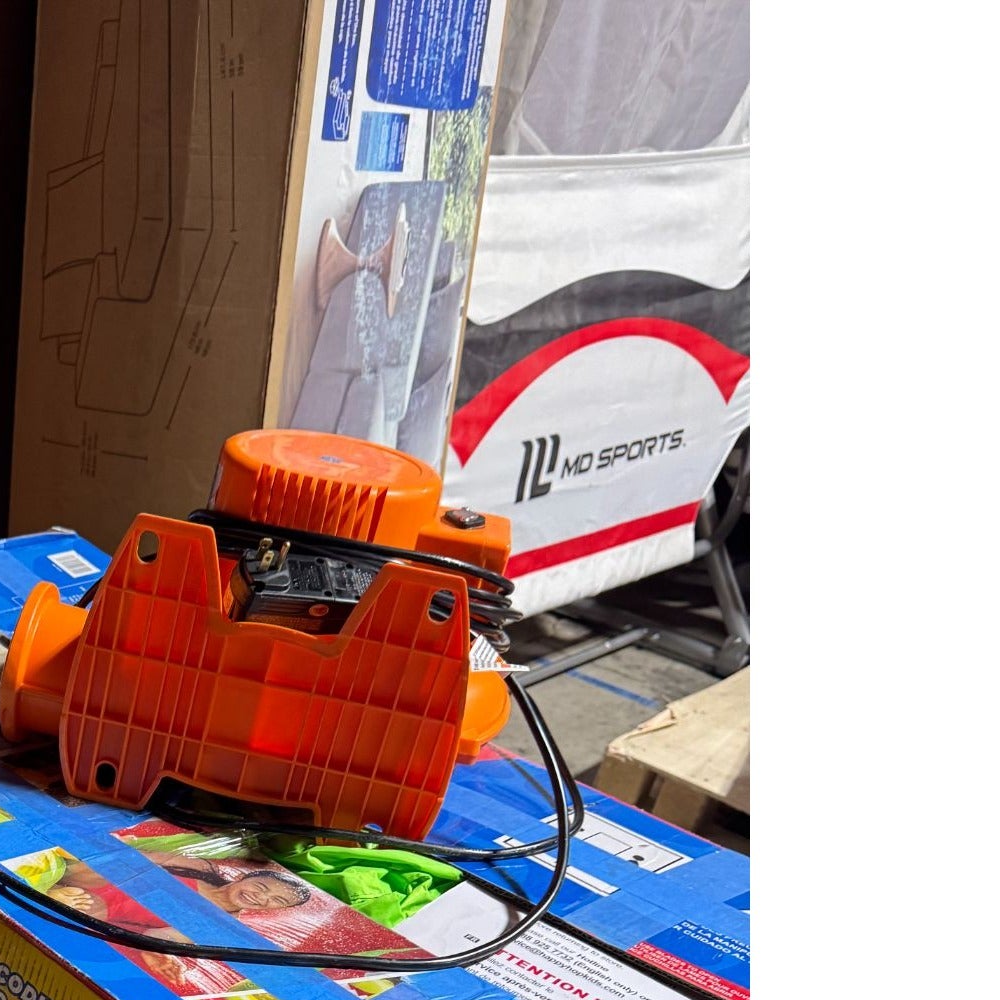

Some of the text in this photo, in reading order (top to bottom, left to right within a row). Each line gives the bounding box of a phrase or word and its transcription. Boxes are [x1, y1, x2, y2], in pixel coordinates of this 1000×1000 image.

[561, 453, 593, 479] MD
[681, 920, 713, 939] DE LA
[533, 936, 550, 950] 925
[552, 948, 575, 962] 7732
[573, 959, 612, 983] (English
[613, 980, 638, 997] only)
[577, 952, 610, 973] Hotline
[731, 952, 747, 962] AL
